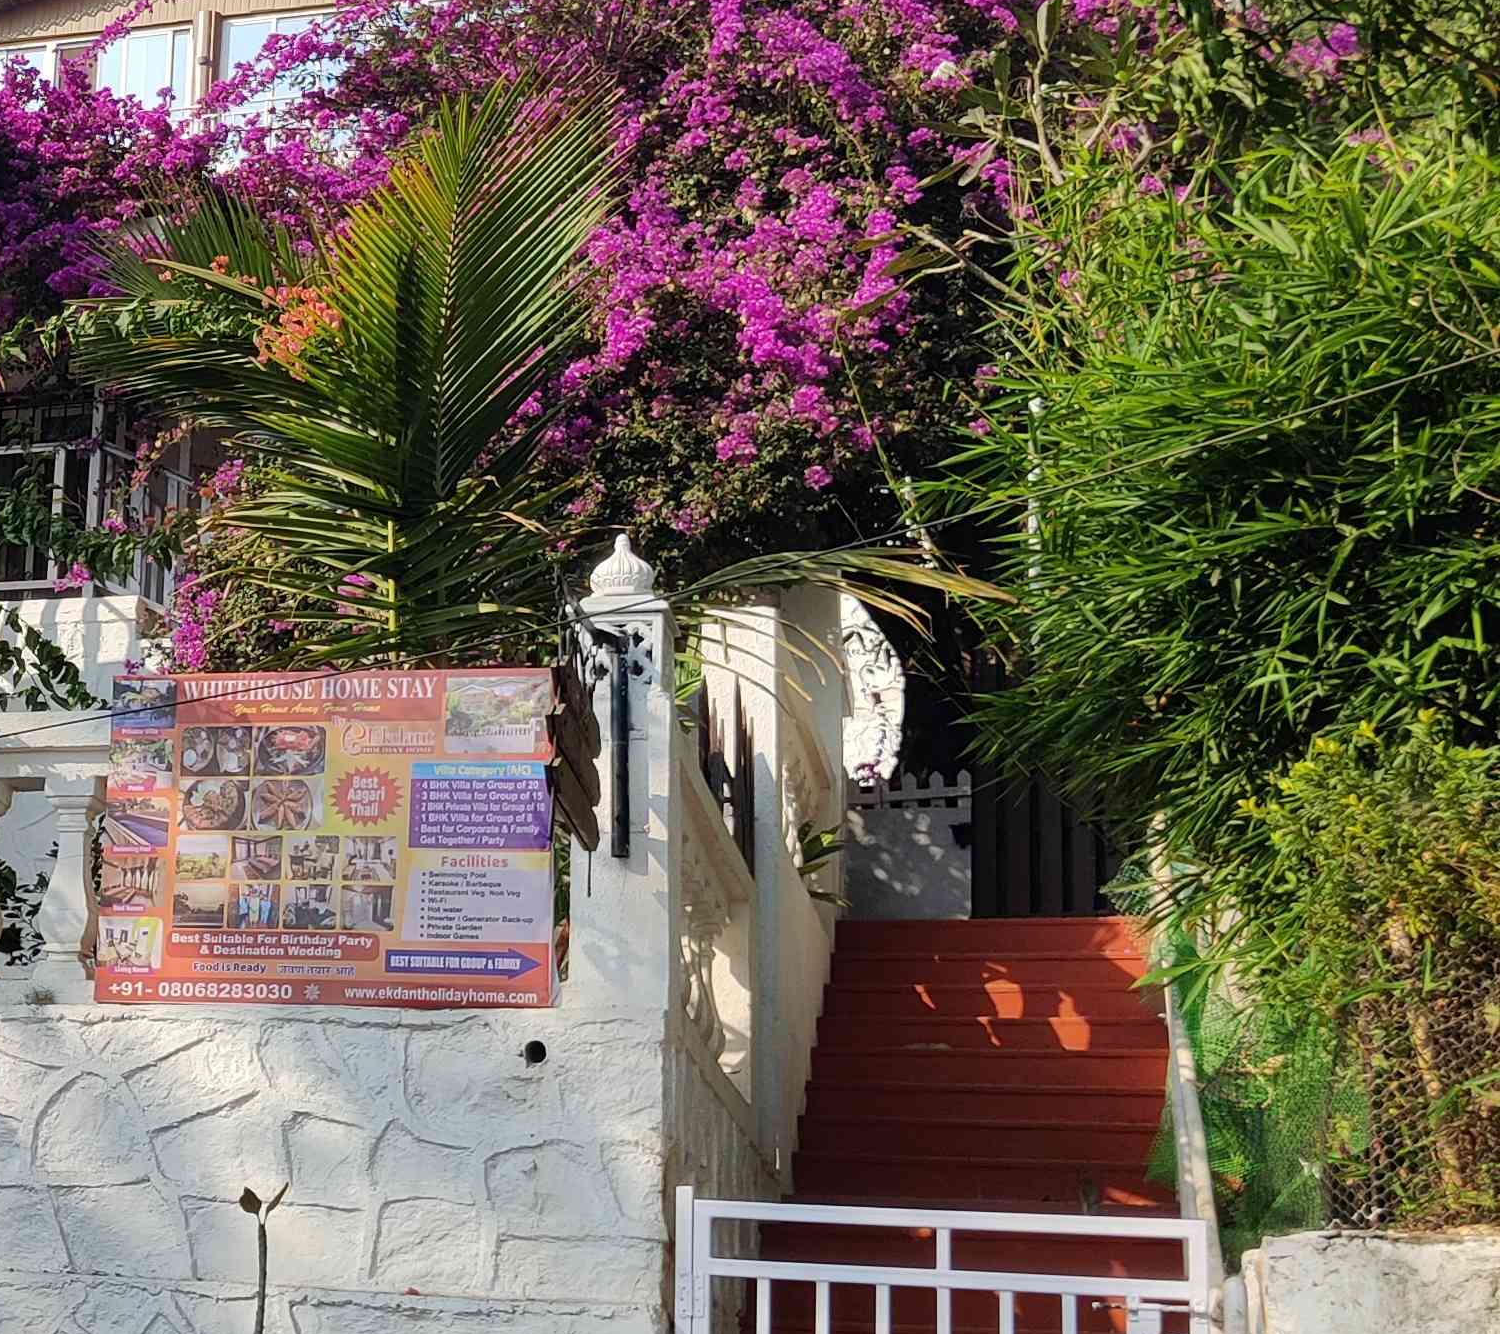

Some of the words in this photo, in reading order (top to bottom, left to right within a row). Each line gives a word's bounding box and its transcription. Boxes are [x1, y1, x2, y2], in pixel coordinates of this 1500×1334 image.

[183, 679, 316, 701] WHITEHOUSE
[320, 677, 381, 700] HOME
[387, 676, 437, 699] STAY
[233, 702, 257, 717] Your
[260, 702, 288, 714] Home
[290, 702, 319, 715] Away
[352, 701, 381, 713] Home
[353, 775, 379, 788] Best
[421, 780, 428, 789] 4
[429, 780, 450, 789] BHK
[451, 780, 471, 789] Villa
[472, 780, 485, 789] for
[486, 780, 515, 791] Group
[516, 780, 526, 789] of
[528, 780, 539, 789] 20
[421, 791, 428, 800] 3
[429, 791, 451, 800] BHK
[452, 791, 472, 800] Villa
[473, 791, 487, 800] for
[488, 791, 518, 802] Group
[519, 791, 530, 800] of
[531, 792, 543, 800] 15
[350, 802, 379, 817] Thali
[427, 802, 444, 811] BHK
[471, 802, 488, 811] Villa
[489, 802, 500, 811] for
[501, 803, 525, 813] Group
[526, 803, 535, 812] of
[428, 813, 449, 822] BHK
[450, 813, 469, 822] Villa
[470, 813, 484, 822] for
[485, 814, 513, 824] Group
[515, 813, 525, 822] of
[420, 824, 440, 833] Best
[441, 824, 454, 833] for
[456, 824, 500, 835] Corporate
[501, 825, 508, 833] &
[510, 825, 540, 835] Family
[420, 835, 436, 844] Get
[438, 835, 476, 846] Together
[482, 835, 505, 846] Party
[441, 854, 509, 868] Facilities
[428, 879, 459, 887] Karaoke
[428, 888, 469, 896] Restaurant
[506, 889, 521, 899] Veg
[462, 915, 500, 923] Generator
[501, 915, 534, 924] Back-up
[426, 923, 453, 931] Private
[454, 923, 483, 931] Garden
[170, 932, 200, 944] Best
[202, 933, 254, 944] Suitable
[257, 934, 278, 944] For
[280, 934, 335, 948] Birthday
[337, 935, 374, 948] Party
[453, 932, 480, 940] Games
[199, 945, 209, 955] &
[213, 946, 285, 957] Destination
[287, 947, 343, 959] Wedding
[192, 962, 219, 972] Food
[233, 962, 267, 974] Ready
[389, 955, 409, 968] BEST
[410, 956, 445, 969] SUITABLE
[445, 956, 461, 969] FOR
[487, 959, 494, 970] &
[494, 957, 522, 971] FAMILY
[108, 981, 153, 998] +91-
[157, 982, 293, 1000] 08068283030
[344, 986, 538, 1005] www.ekdantholidayhome.com
